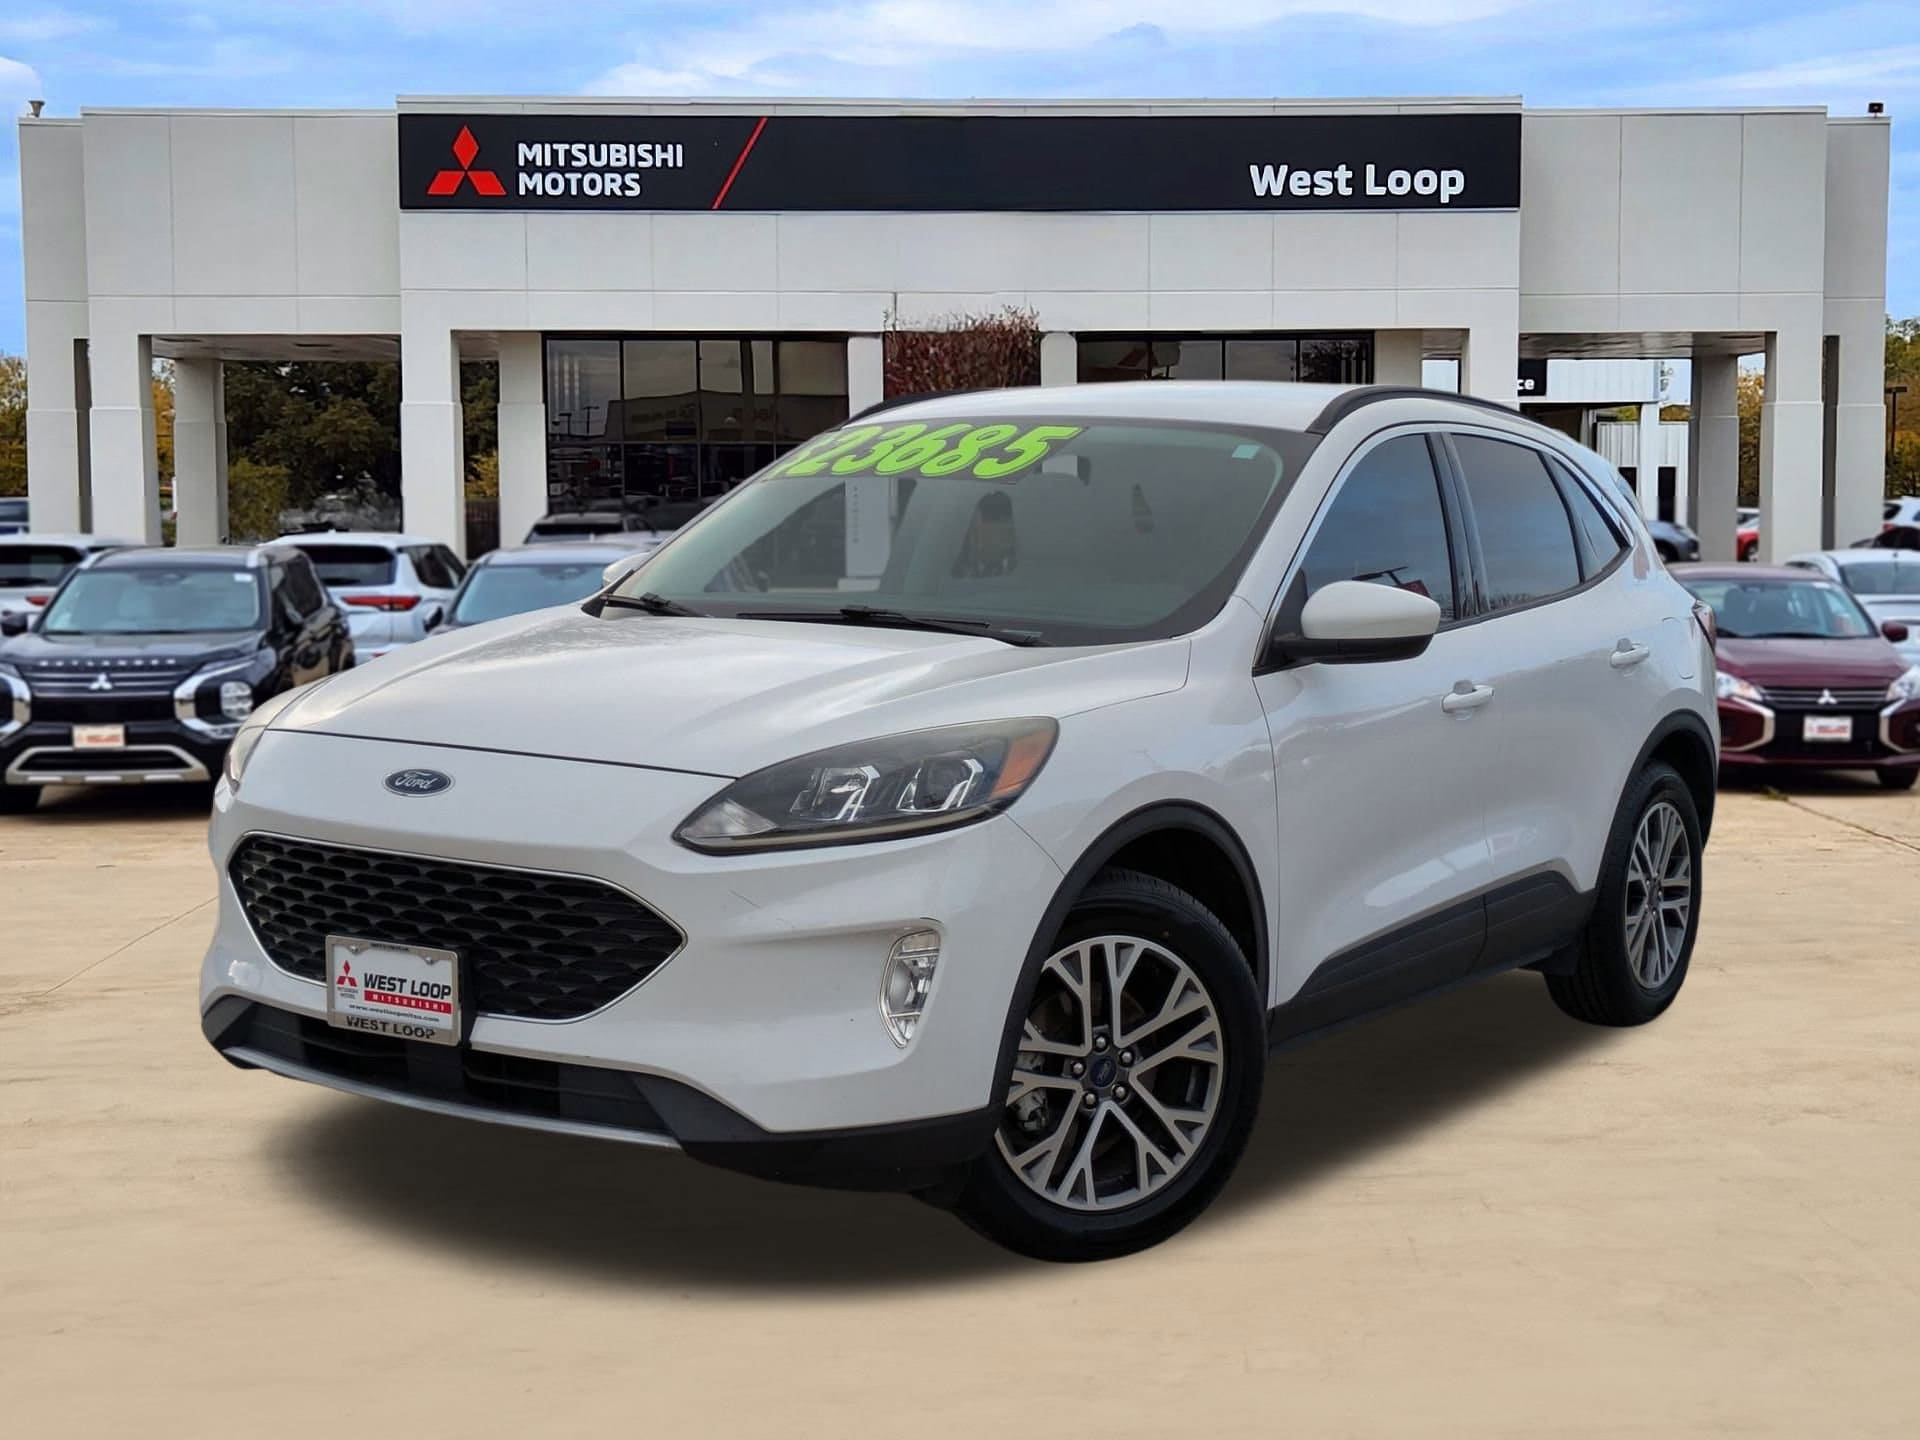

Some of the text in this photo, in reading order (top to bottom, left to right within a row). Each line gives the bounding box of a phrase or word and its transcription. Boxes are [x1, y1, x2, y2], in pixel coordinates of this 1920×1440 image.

[518, 143, 683, 168] MITSUBISHI
[518, 172, 641, 197] MOTORS
[1249, 164, 1465, 203] West Loop
[394, 770, 439, 789] Ford
[364, 972, 452, 1000] WEST LOOP
[372, 993, 445, 1011] MITSUBISHI
[345, 1015, 436, 1039] WEST LOOP
